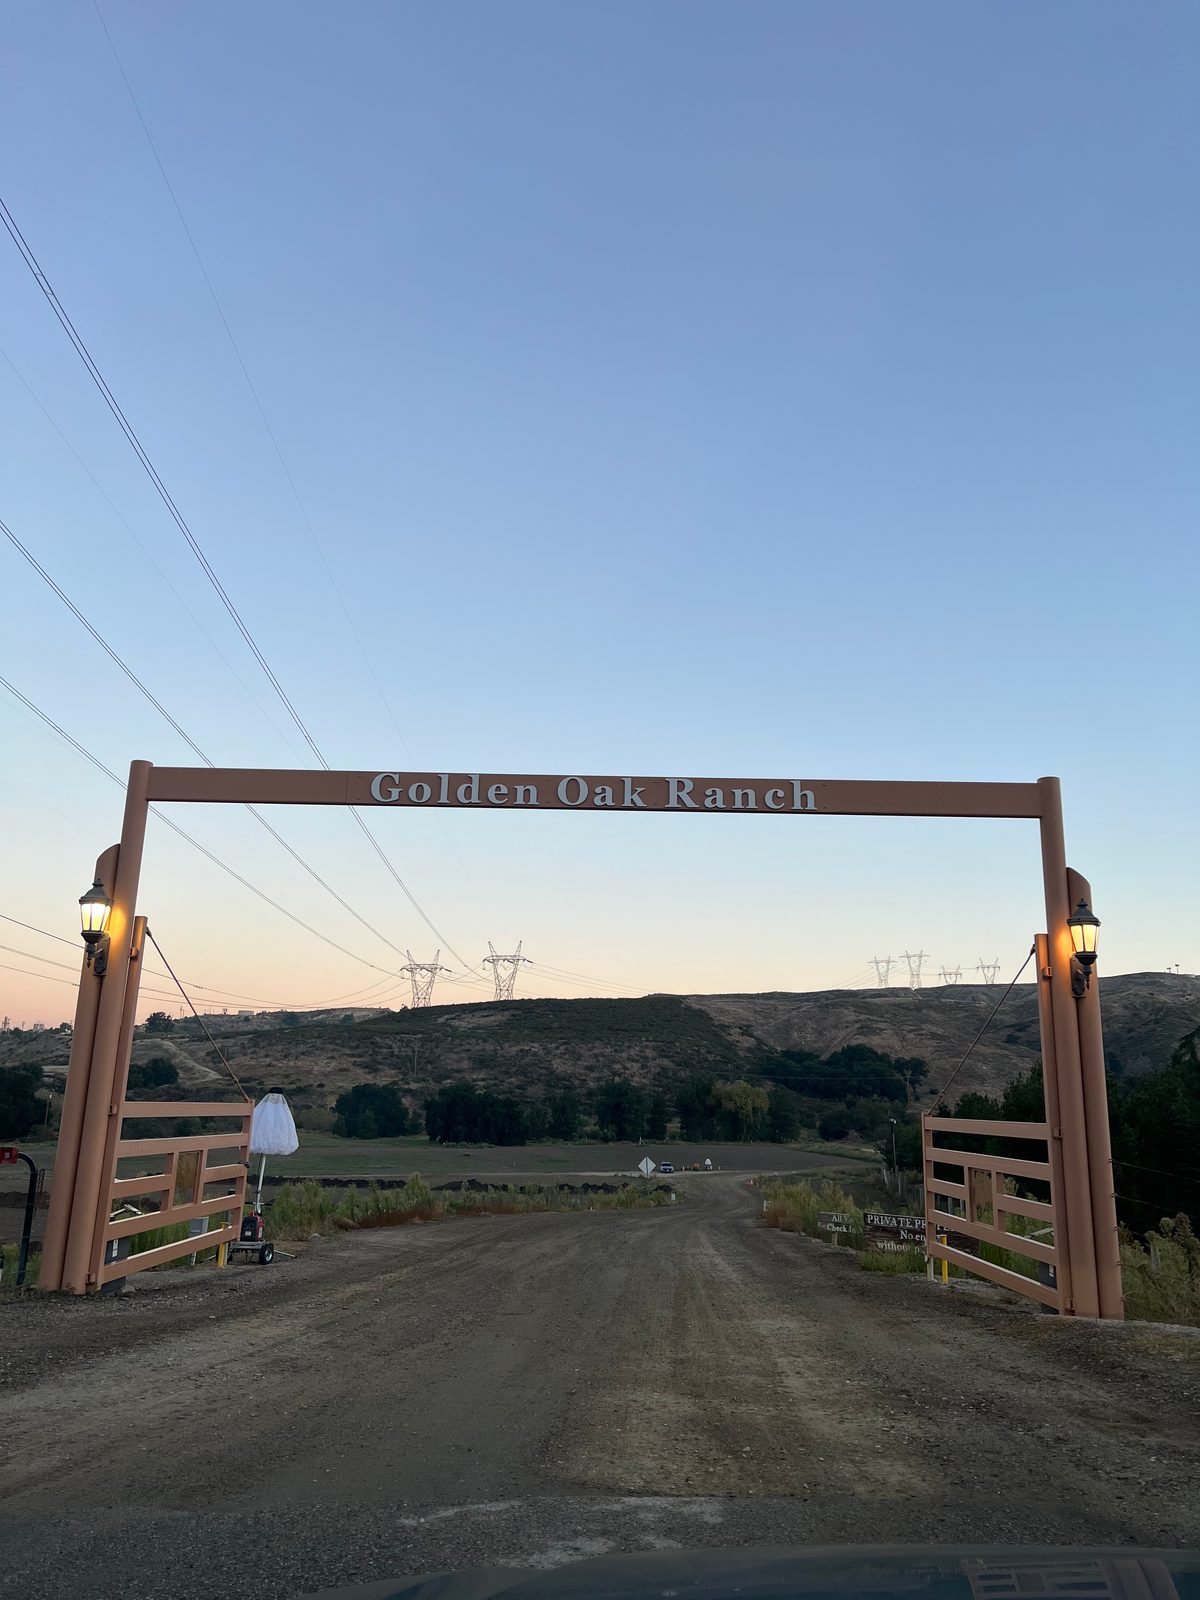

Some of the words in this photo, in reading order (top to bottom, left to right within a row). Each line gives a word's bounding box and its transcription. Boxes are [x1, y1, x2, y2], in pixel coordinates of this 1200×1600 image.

[370, 773, 540, 806] Golden
[557, 776, 658, 809] Oak
[665, 777, 818, 812] Ranch
[832, 1214, 842, 1222] All
[867, 1214, 912, 1228] PRIVATE
[826, 1223, 848, 1233] Check
[900, 1230, 914, 1240] No
